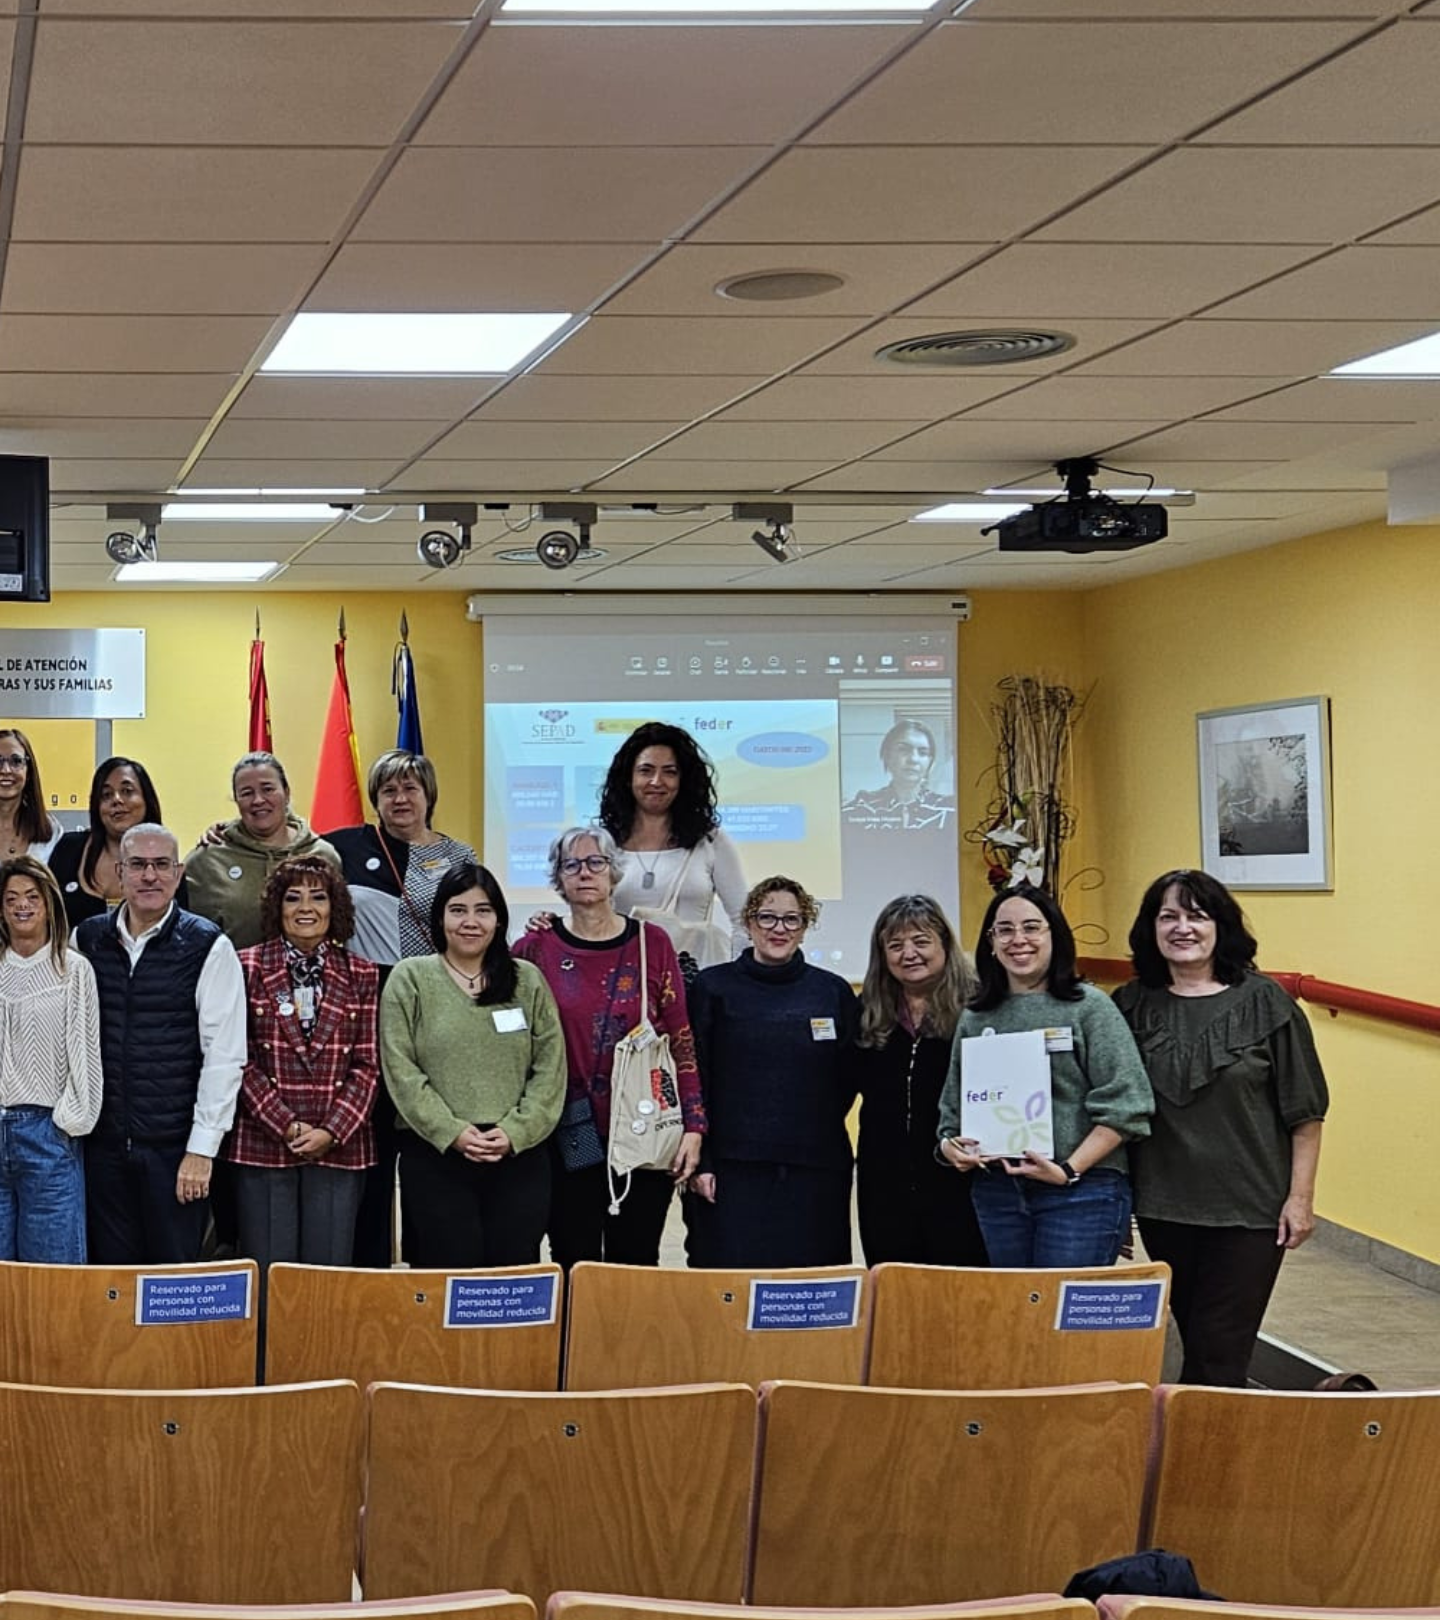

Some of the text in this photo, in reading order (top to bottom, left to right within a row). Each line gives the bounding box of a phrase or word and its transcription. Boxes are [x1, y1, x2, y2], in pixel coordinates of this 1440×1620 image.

[6, 659, 22, 671] DE
[24, 656, 87, 671] ATENCIÓN
[23, 679, 32, 690] Y
[34, 679, 56, 691] SUS
[59, 678, 113, 691] FAMILIAS
[694, 718, 733, 730] feder
[531, 724, 576, 738] SEPAD
[966, 1090, 1004, 1102] feder
[150, 1283, 227, 1294] Reservado para
[459, 1286, 534, 1296] Reservado para
[762, 1290, 837, 1299] Reservado para
[1071, 1292, 1143, 1303] Reservado para
[150, 1296, 214, 1307] personas con
[457, 1298, 522, 1308] personas con
[149, 1304, 240, 1317] movilidad reducida
[456, 1306, 546, 1318] movilidad reducida
[761, 1303, 805, 1313] personas
[1069, 1306, 1112, 1315] personas
[760, 1312, 849, 1323] movilidad reducida
[1068, 1314, 1152, 1325] movilidad reducida
